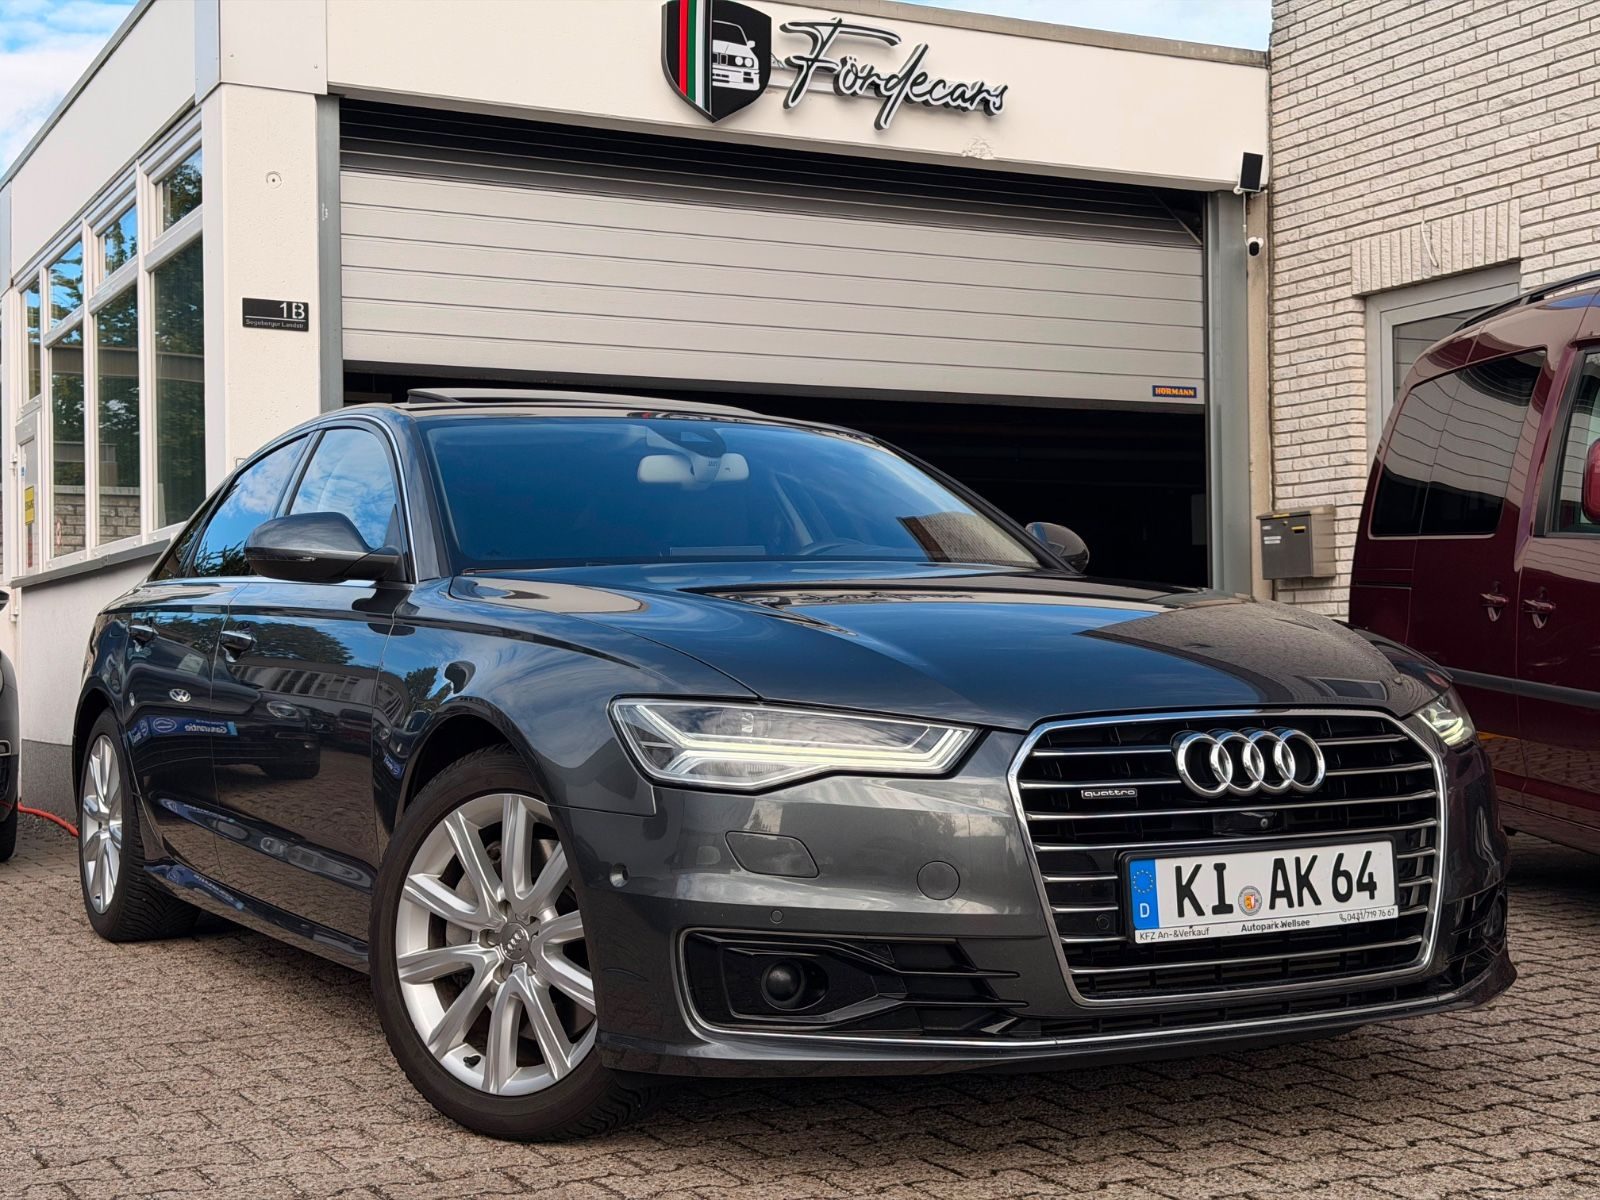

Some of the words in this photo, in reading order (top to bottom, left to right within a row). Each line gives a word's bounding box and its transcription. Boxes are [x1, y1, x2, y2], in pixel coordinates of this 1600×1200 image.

[279, 302, 306, 319] 1B
[1084, 789, 1136, 798] quattro
[1174, 862, 1234, 918] KI
[1269, 854, 1322, 910] AK
[1331, 850, 1378, 903] 64
[1139, 902, 1150, 918] D
[1140, 931, 1156, 941] KFZ
